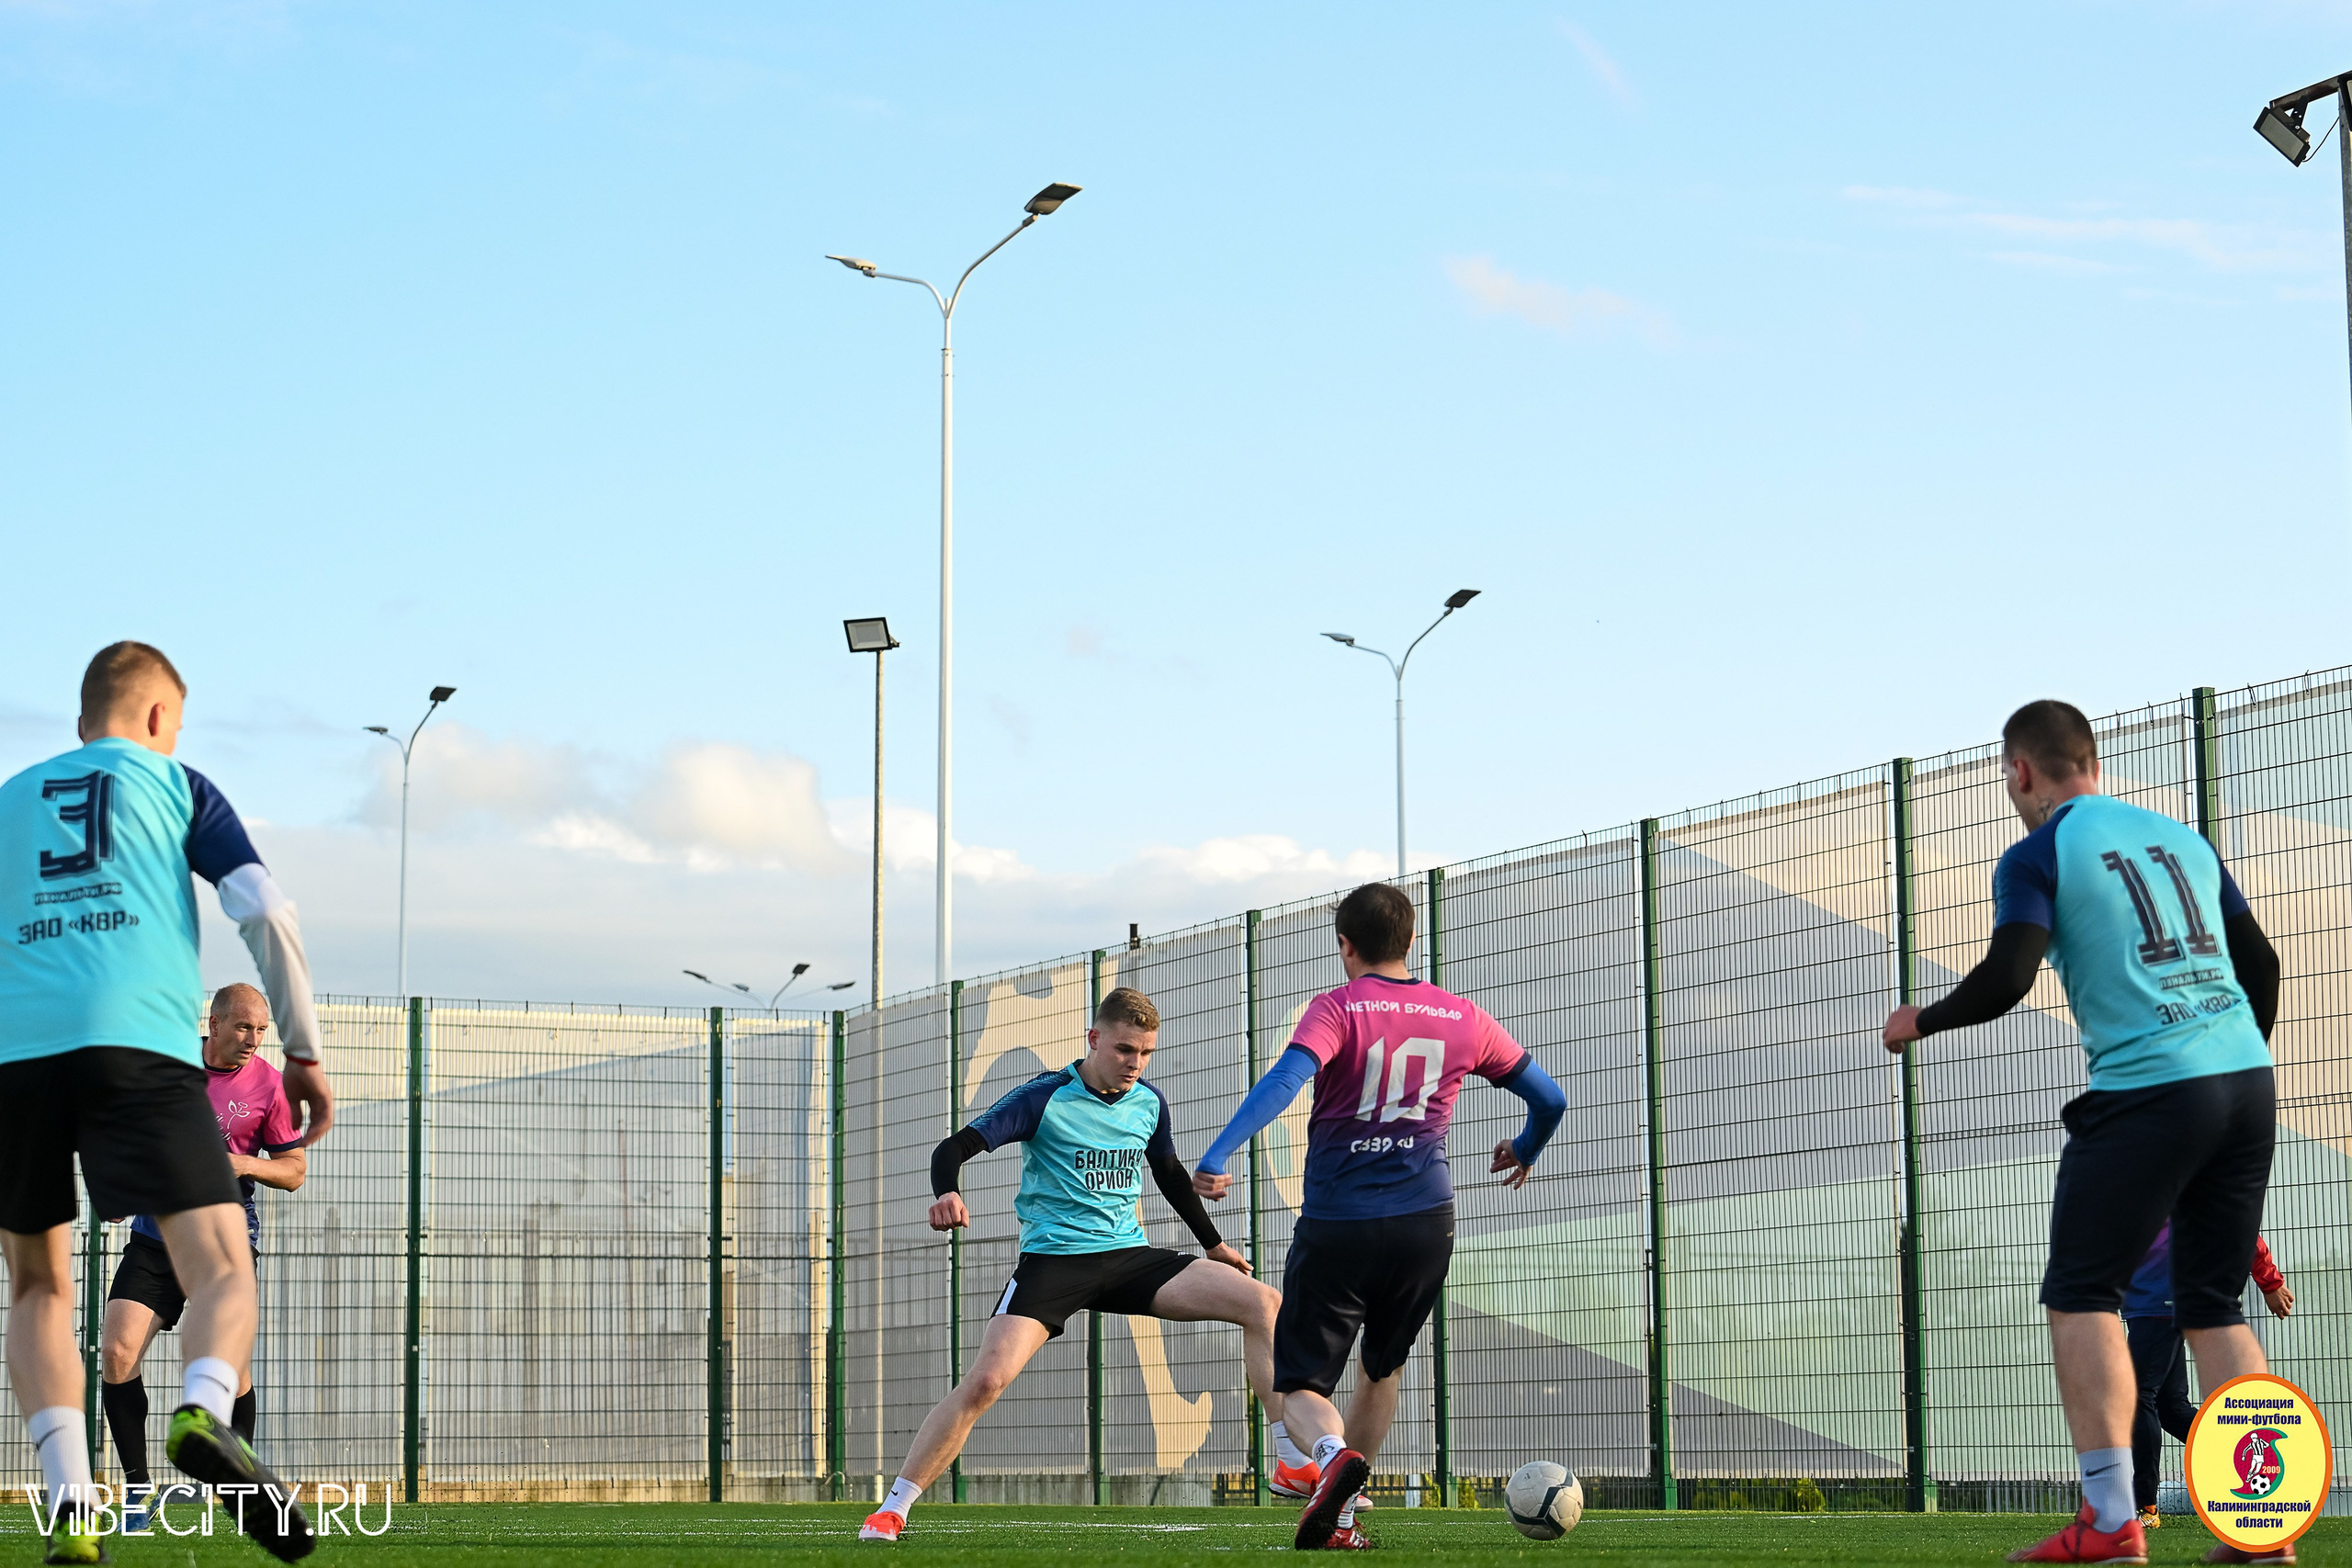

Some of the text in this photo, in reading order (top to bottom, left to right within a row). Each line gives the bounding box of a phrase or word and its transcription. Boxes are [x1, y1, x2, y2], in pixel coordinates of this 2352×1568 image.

[40, 769, 115, 882] 3
[2099, 844, 2222, 967] 11
[18, 917, 62, 945] ЗАО
[1404, 1002, 1463, 1021] БУЛЬВАР
[1354, 1036, 1445, 1123] 10
[1075, 1148, 1143, 1169] БАЛТИКА
[1085, 1169, 1134, 1190] ОРИОН
